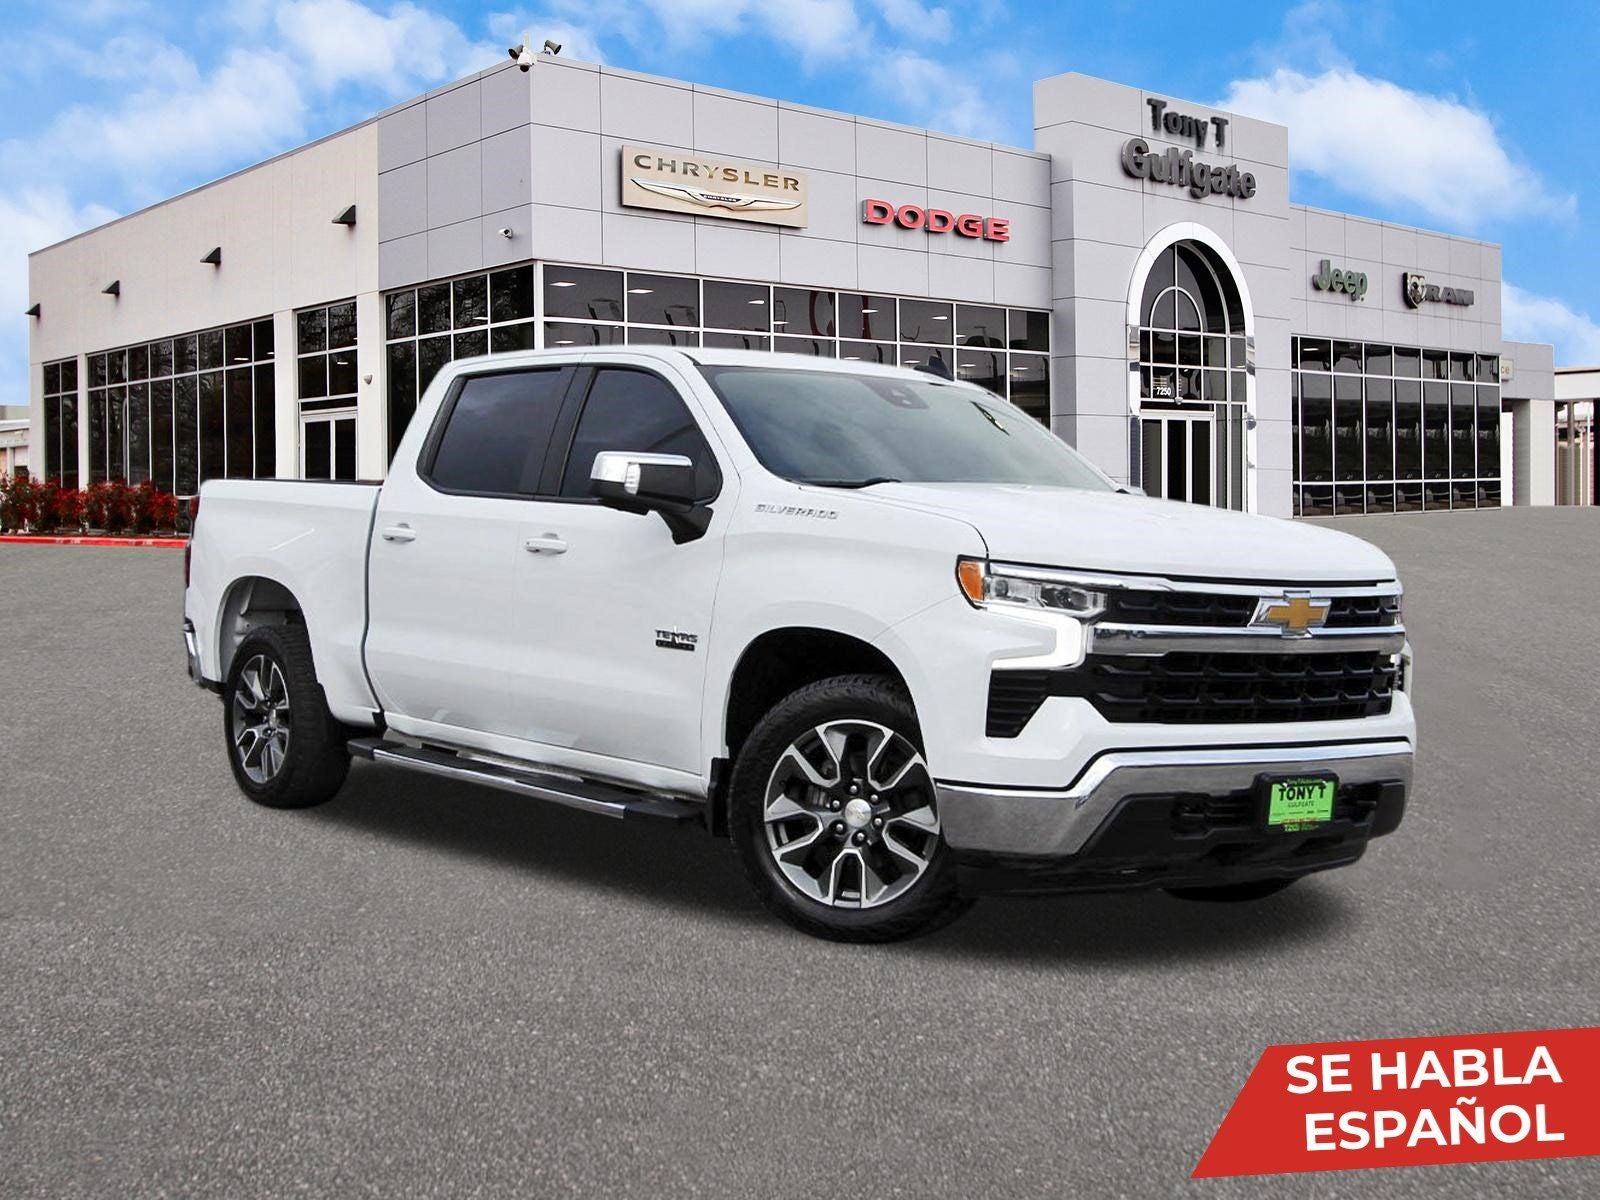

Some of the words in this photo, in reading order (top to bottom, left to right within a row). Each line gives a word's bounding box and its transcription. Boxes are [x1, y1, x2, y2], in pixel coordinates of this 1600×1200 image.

[1147, 98, 1208, 148] Tony
[1211, 116, 1229, 147] T
[633, 153, 800, 192] CHRYSLER
[1121, 138, 1257, 199] Gulfgate
[862, 198, 1011, 242] DODGE
[1312, 259, 1368, 302] Jeep
[1425, 284, 1475, 307] RAM
[1156, 387, 1171, 395] 7250
[755, 504, 838, 519] SILVERADO
[1279, 785, 1315, 801] TONY
[1318, 784, 1326, 799] T
